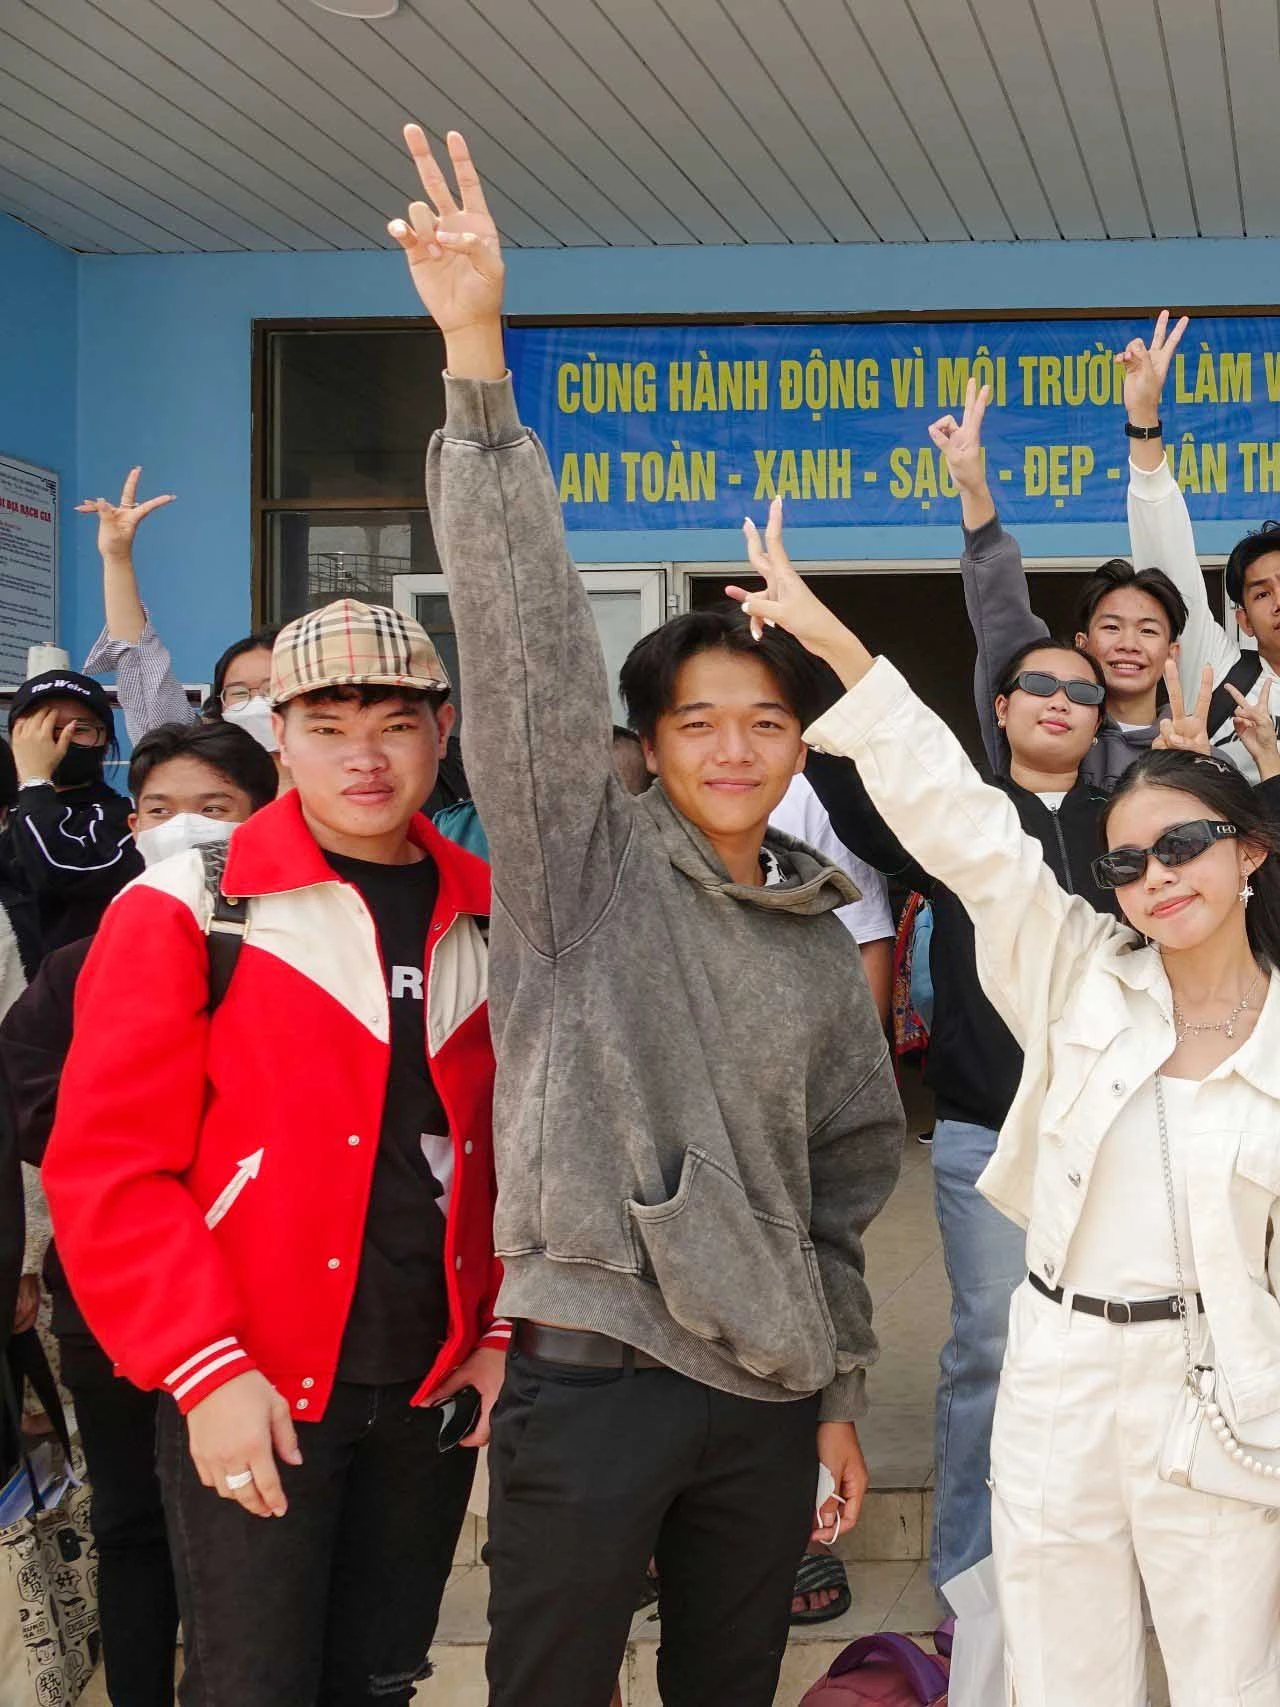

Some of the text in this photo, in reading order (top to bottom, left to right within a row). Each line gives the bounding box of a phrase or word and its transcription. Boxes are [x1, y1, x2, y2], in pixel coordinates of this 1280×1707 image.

[558, 352, 656, 413] CÙNG
[669, 350, 768, 410] HÀNH
[779, 349, 879, 421] ĐỘNG
[891, 347, 924, 408] VÌ
[937, 345, 1006, 408] MÔI
[1176, 342, 1252, 404] LÀM
[560, 452, 609, 504] AN
[621, 440, 716, 503] TOÀN
[754, 449, 851, 500] XANH
[889, 447, 986, 509] SẠC
[1024, 445, 1094, 508] ĐẸP
